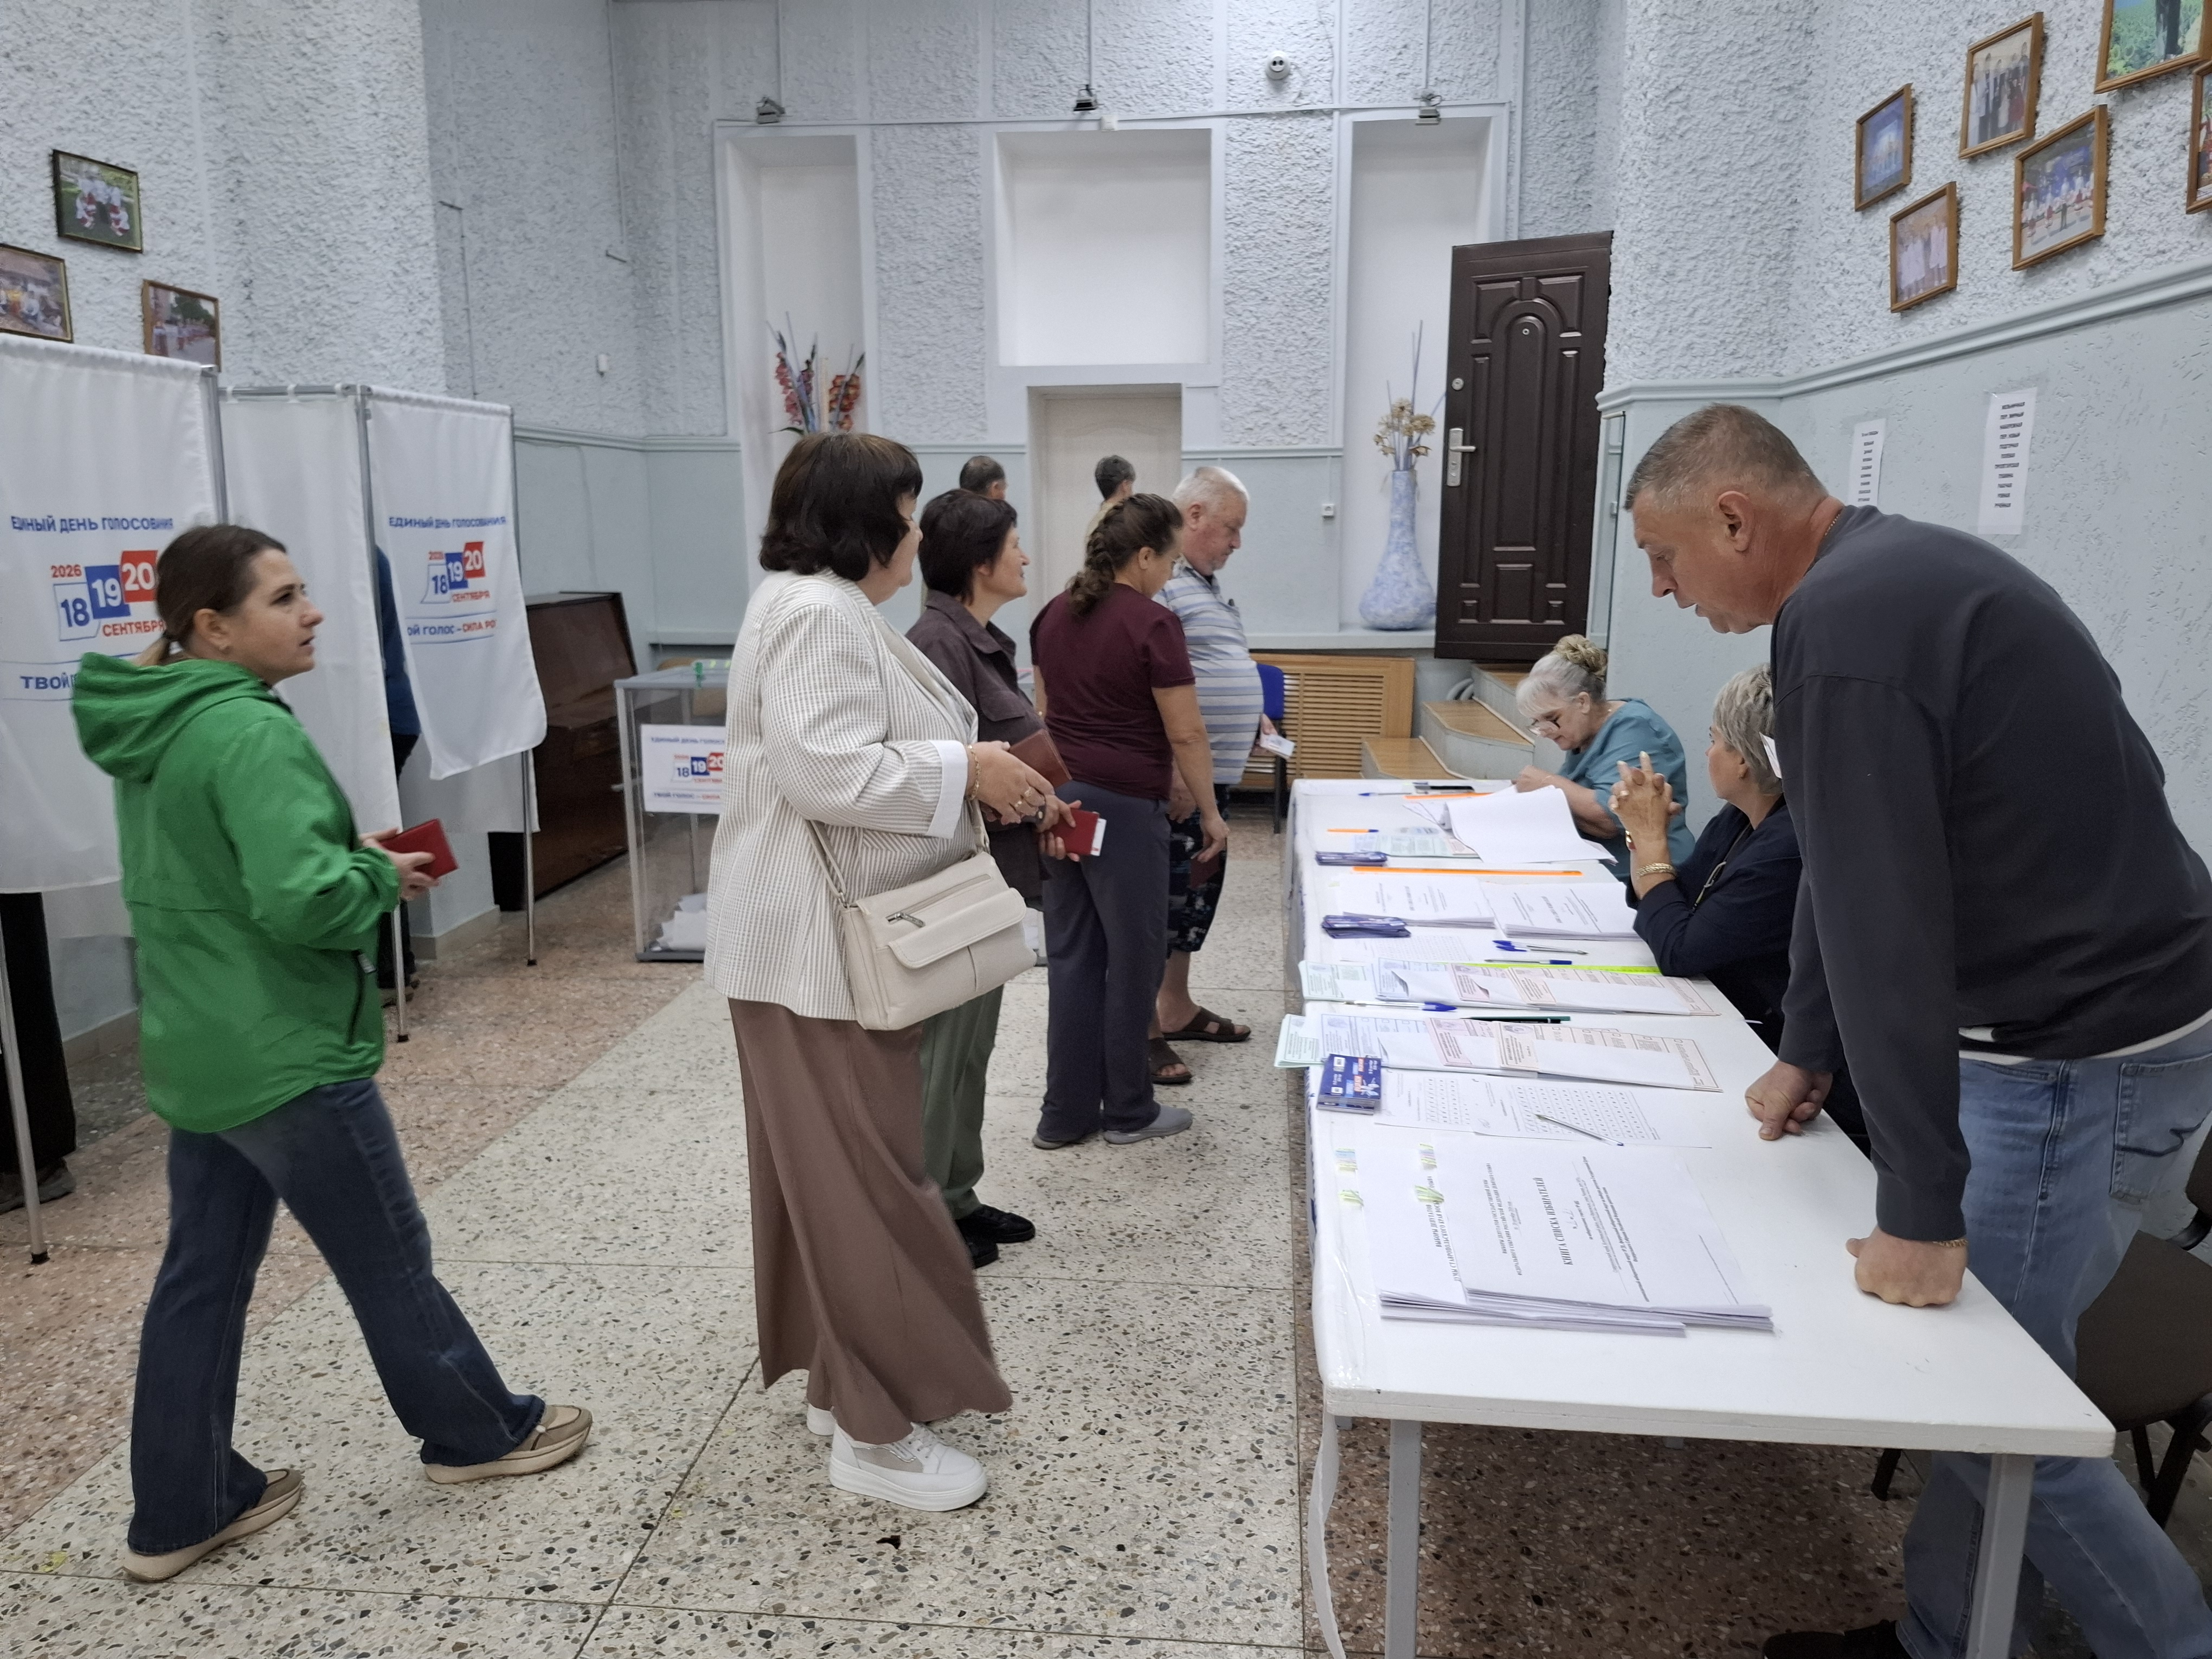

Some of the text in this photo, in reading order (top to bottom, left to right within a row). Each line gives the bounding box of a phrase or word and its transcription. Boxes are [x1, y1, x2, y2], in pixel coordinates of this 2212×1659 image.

[11, 516, 56, 532] ЕНЫЙ
[60, 518, 98, 533] ДЕНЬ
[51, 564, 82, 578] 2026
[432, 575, 448, 594] 18
[448, 561, 463, 582] 19
[465, 550, 482, 571] 20
[61, 562, 156, 628] 18 19 20
[423, 624, 454, 635] ГОЛОС
[20, 672, 70, 690] ТВОЙ
[677, 767, 690, 777] 18
[692, 760, 707, 773] 19
[1533, 1177, 1556, 1216] ИЗБИРАТЕЛЕЙ
[1425, 1204, 1442, 1248] ВЫБОРЫ ДЕПУТАТОВ
[1549, 1217, 1565, 1242] СПИСКА
[1439, 1225, 1457, 1268] СТАВРОПОЛЬСКОГО
[1558, 1243, 1573, 1265] КНИГА
